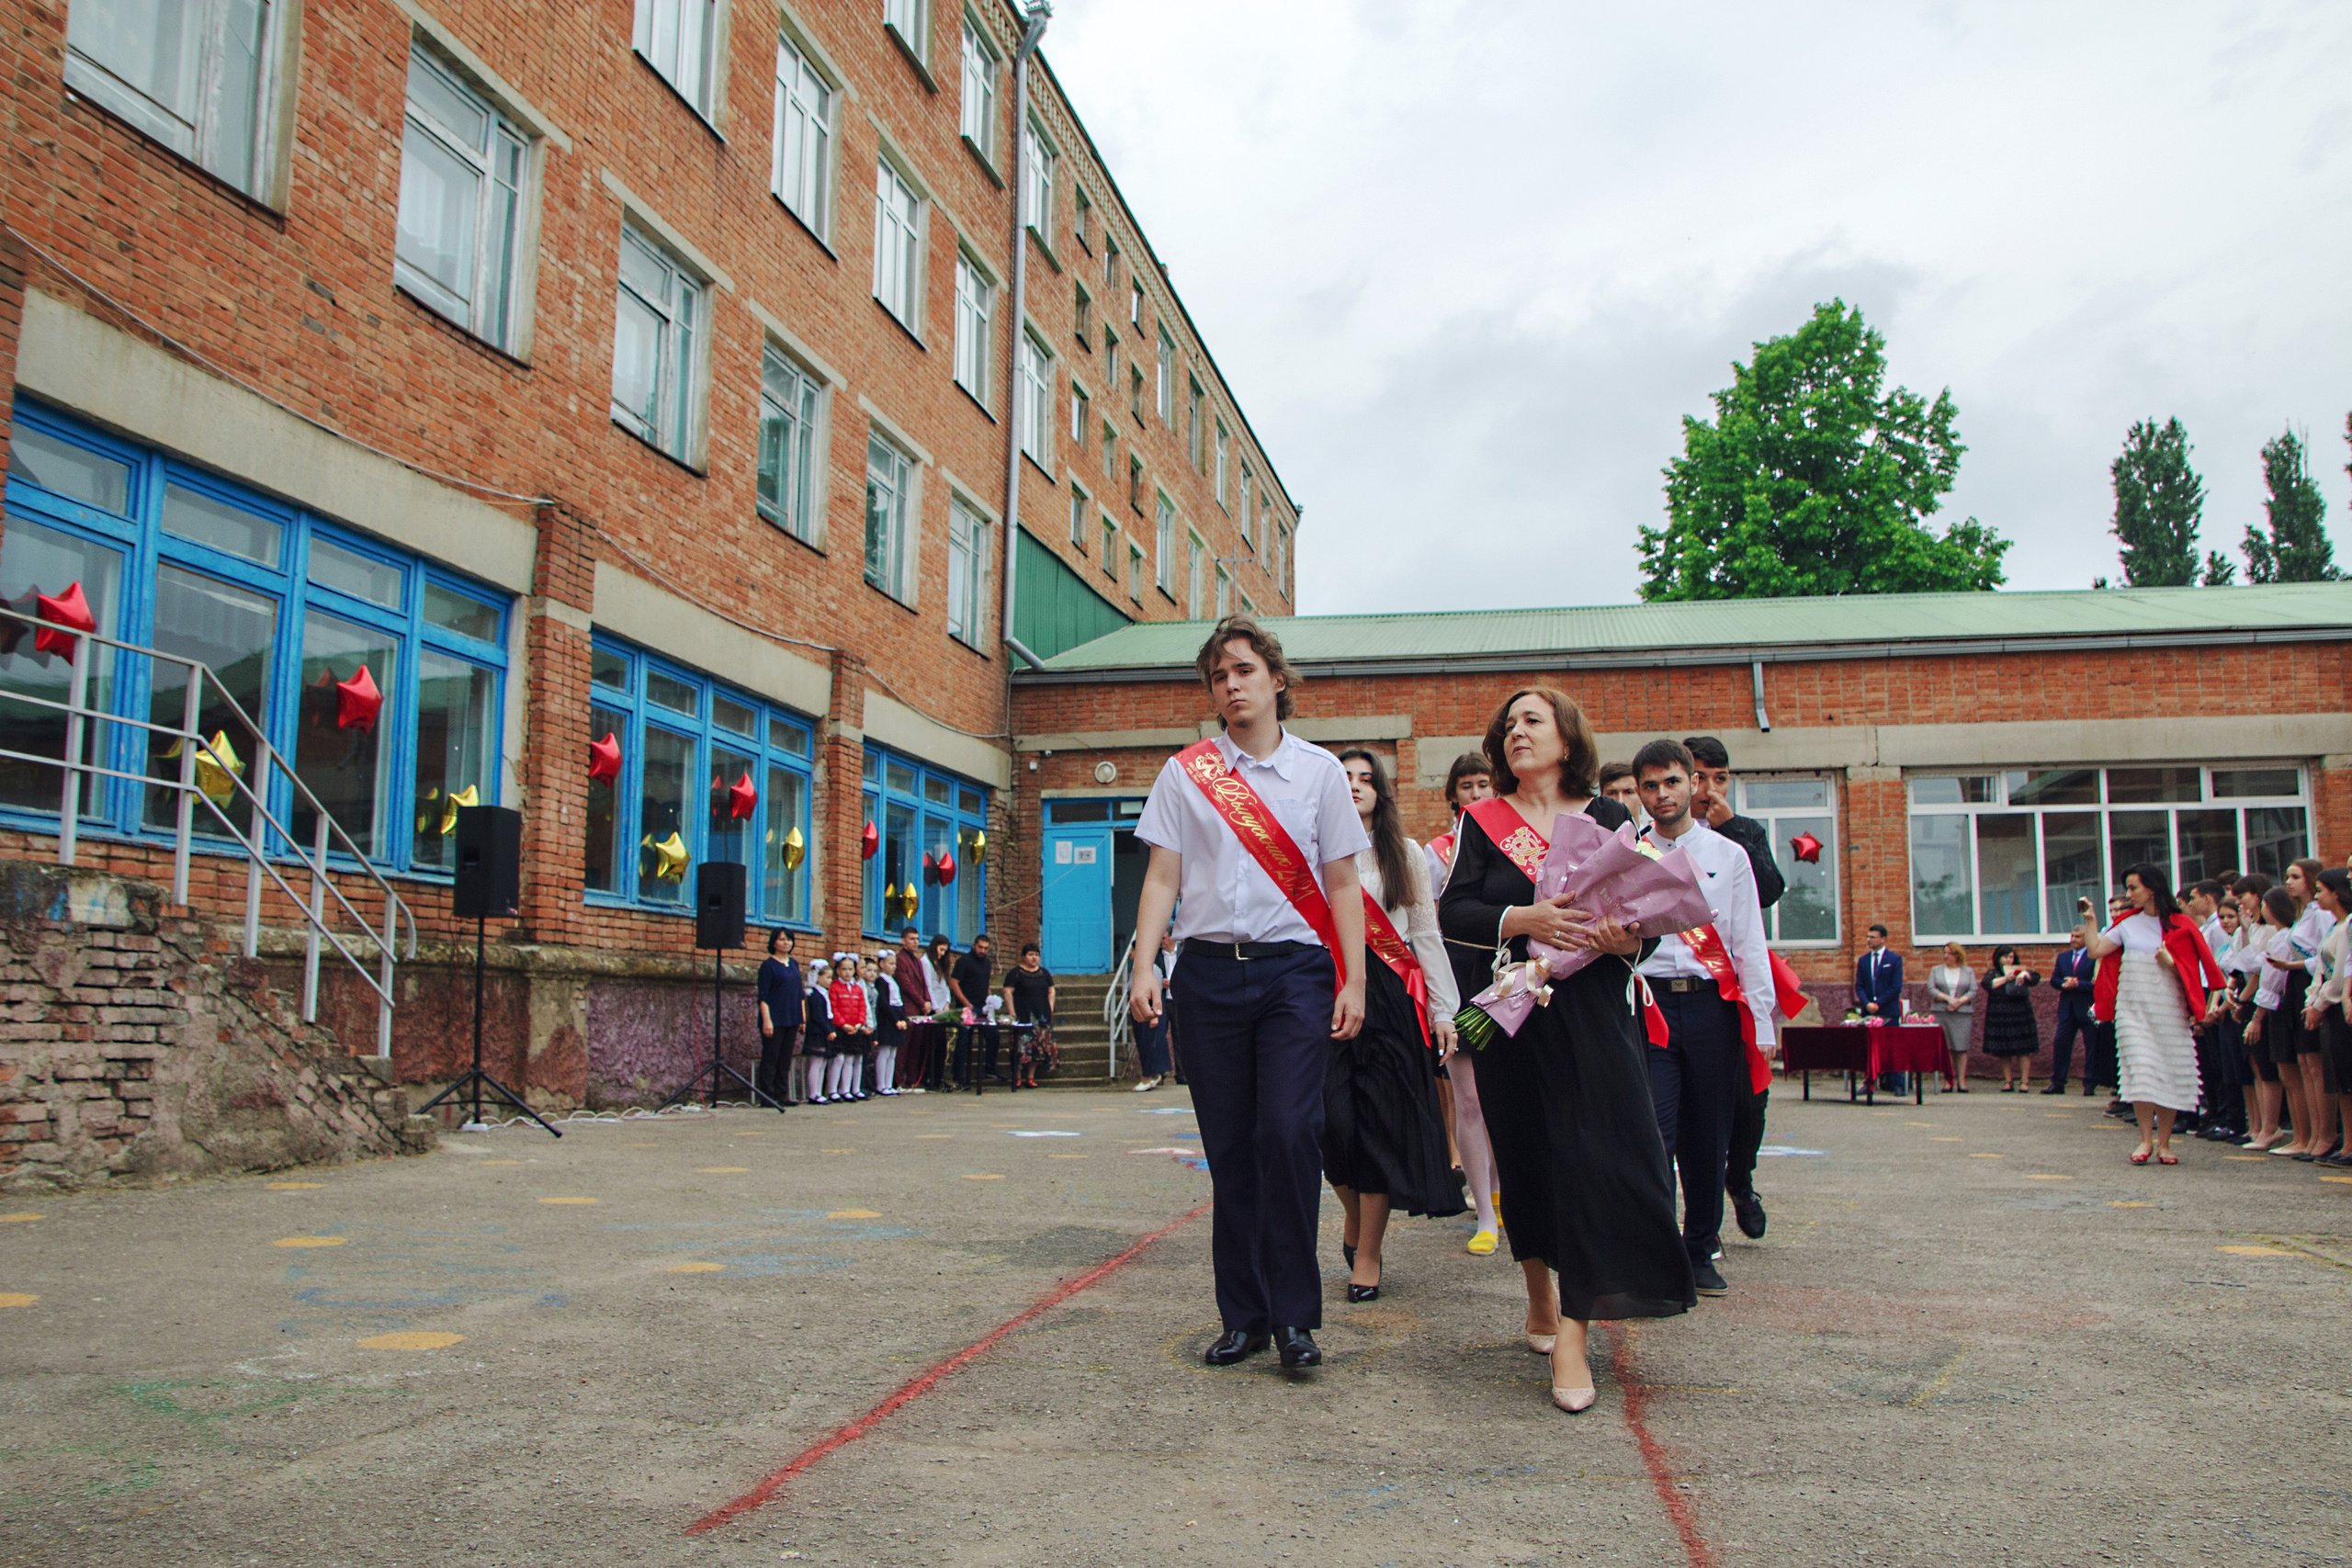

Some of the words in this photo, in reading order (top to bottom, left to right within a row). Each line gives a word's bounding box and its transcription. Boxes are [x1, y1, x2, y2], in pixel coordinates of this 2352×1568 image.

[1212, 777, 1292, 867] Выпускник
[1275, 863, 1316, 902] 2021
[1371, 933, 1410, 964] 2021
[1693, 942, 1732, 972] 2021
